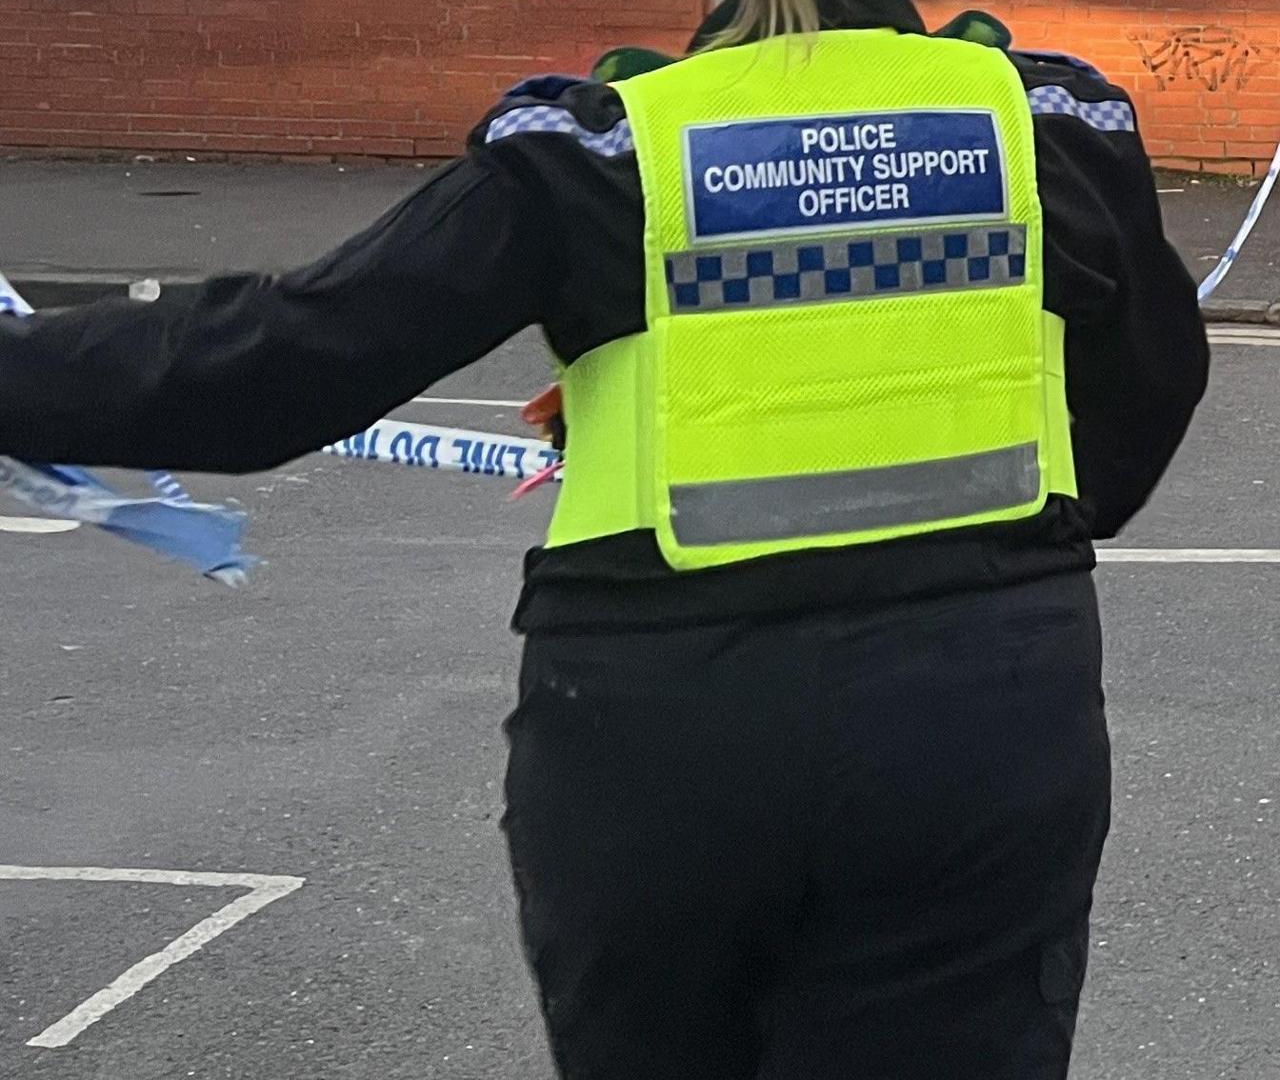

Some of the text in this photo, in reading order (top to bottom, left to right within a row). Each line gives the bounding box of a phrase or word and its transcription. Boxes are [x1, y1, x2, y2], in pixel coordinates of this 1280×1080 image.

[801, 124, 896, 154] POLICE
[704, 149, 989, 193] COMMUNITY SUPPORT
[799, 183, 909, 217] OFFICER
